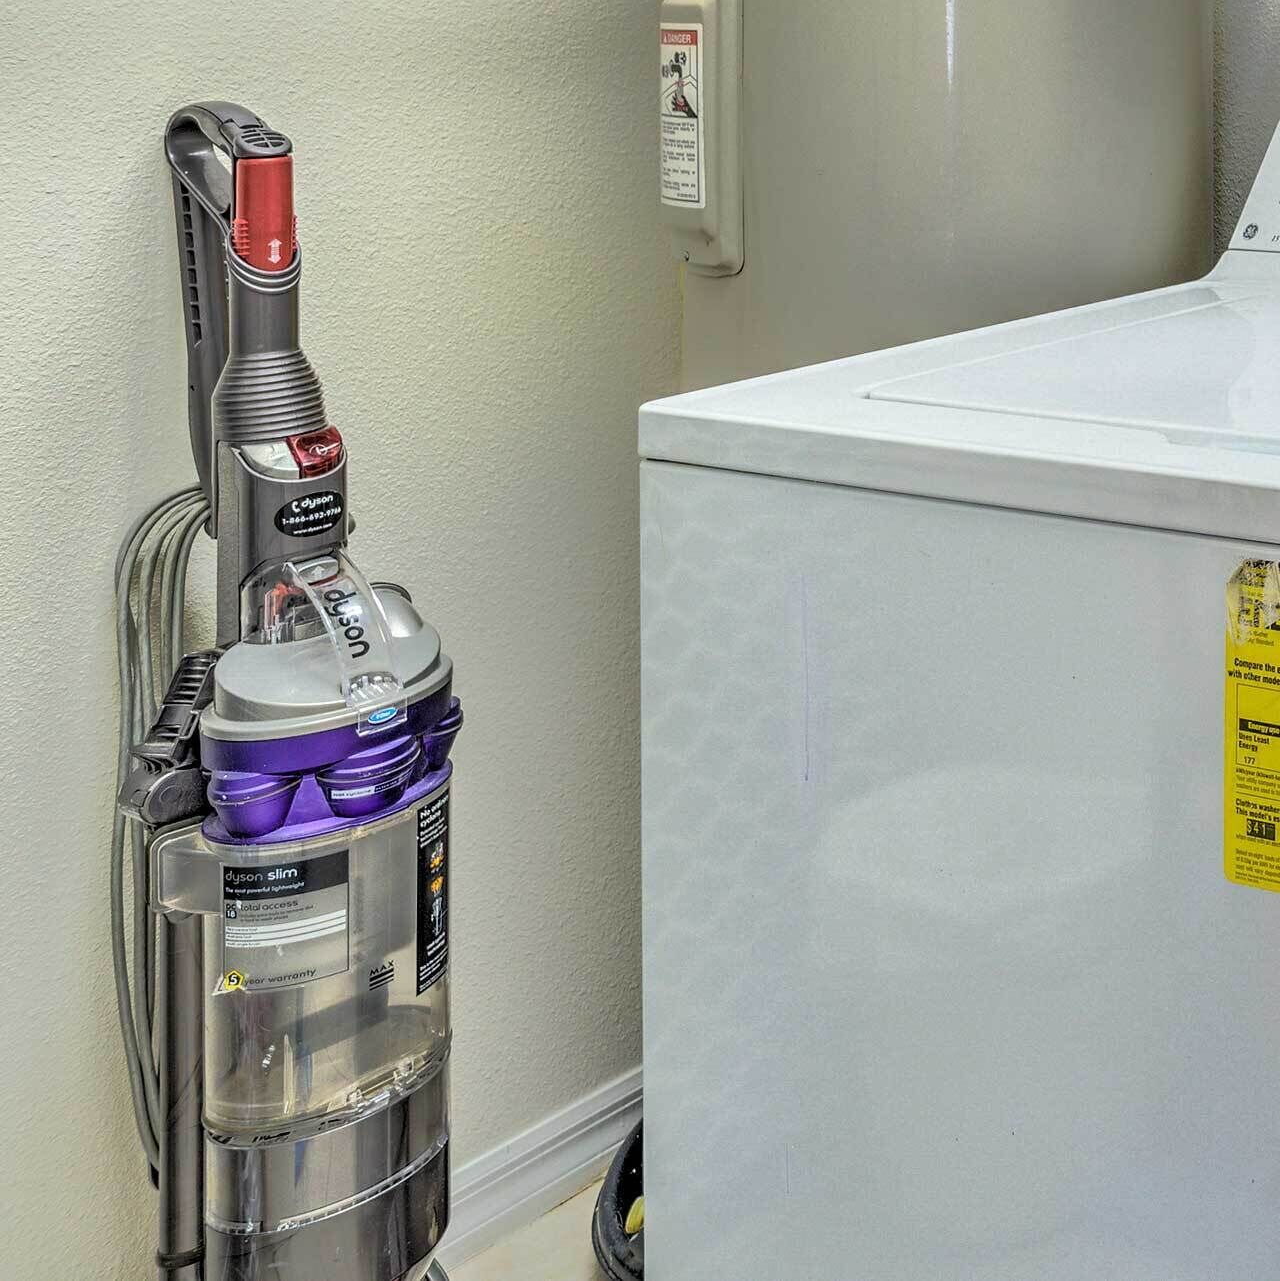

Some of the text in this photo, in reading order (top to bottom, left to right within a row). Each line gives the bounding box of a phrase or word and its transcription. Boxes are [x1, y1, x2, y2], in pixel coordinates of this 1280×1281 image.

[668, 33, 692, 44] DANGER
[302, 495, 333, 508] dyson
[324, 589, 370, 659] dyson
[1234, 657, 1263, 672] Compare
[1265, 663, 1276, 673] the
[1228, 669, 1242, 678] with
[1244, 672, 1261, 682] other
[1248, 722, 1268, 734] Energy
[1239, 732, 1270, 745] Uses Least
[1239, 741, 1258, 752] Energy
[1244, 756, 1255, 765] 177
[1235, 798, 1258, 810] Clothes
[420, 808, 431, 818] No
[1236, 807, 1249, 816] This
[1249, 810, 1273, 821] model's
[226, 868, 297, 884] dyson slim
[271, 882, 305, 892] lightweight
[240, 903, 261, 912] total
[262, 900, 298, 910] access
[370, 961, 394, 976] MAX
[230, 969, 316, 987] 5 year warranty
